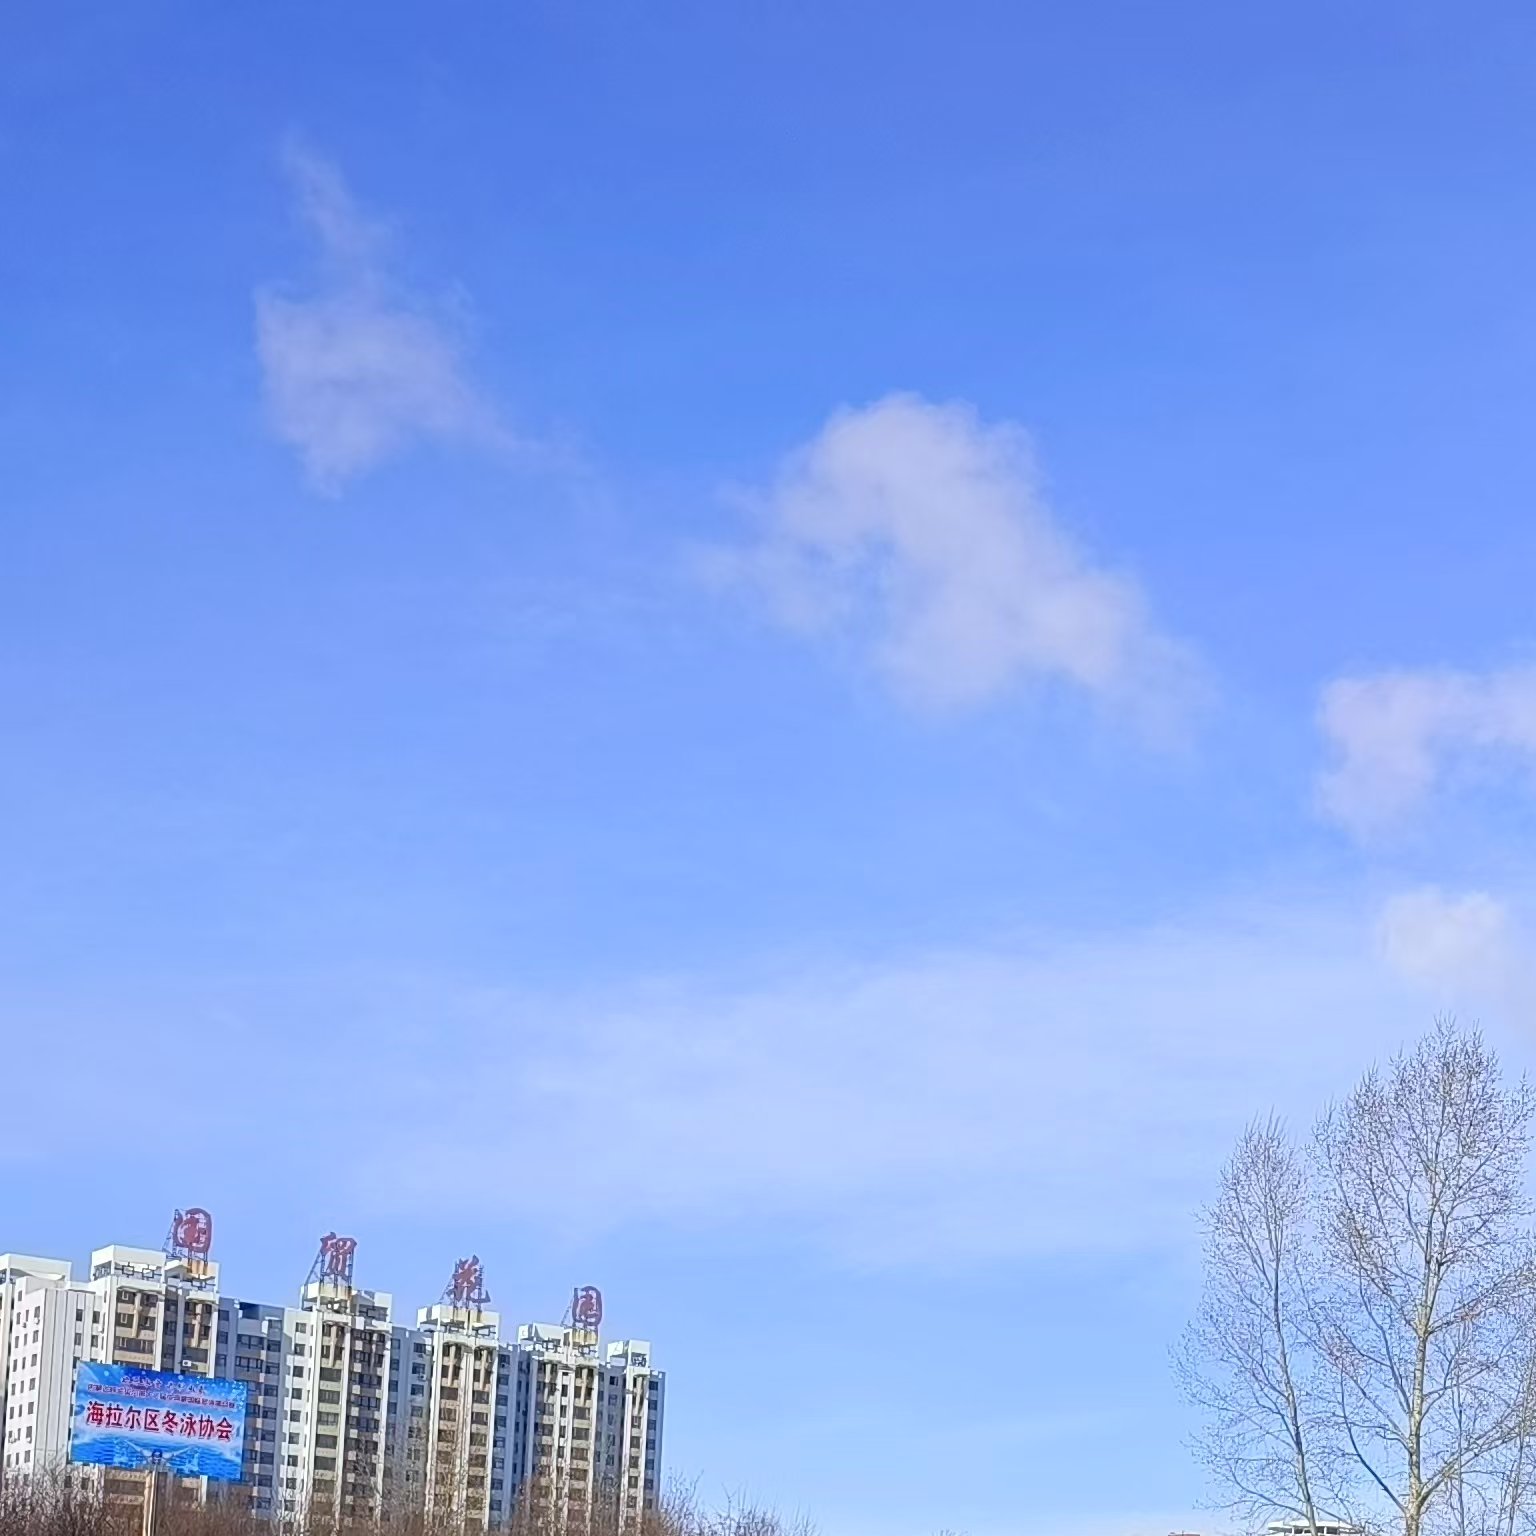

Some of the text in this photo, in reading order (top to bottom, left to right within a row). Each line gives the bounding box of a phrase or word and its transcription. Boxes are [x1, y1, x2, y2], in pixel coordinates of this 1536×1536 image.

[86, 1401, 233, 1440] 海拉尔区冬泳协会
